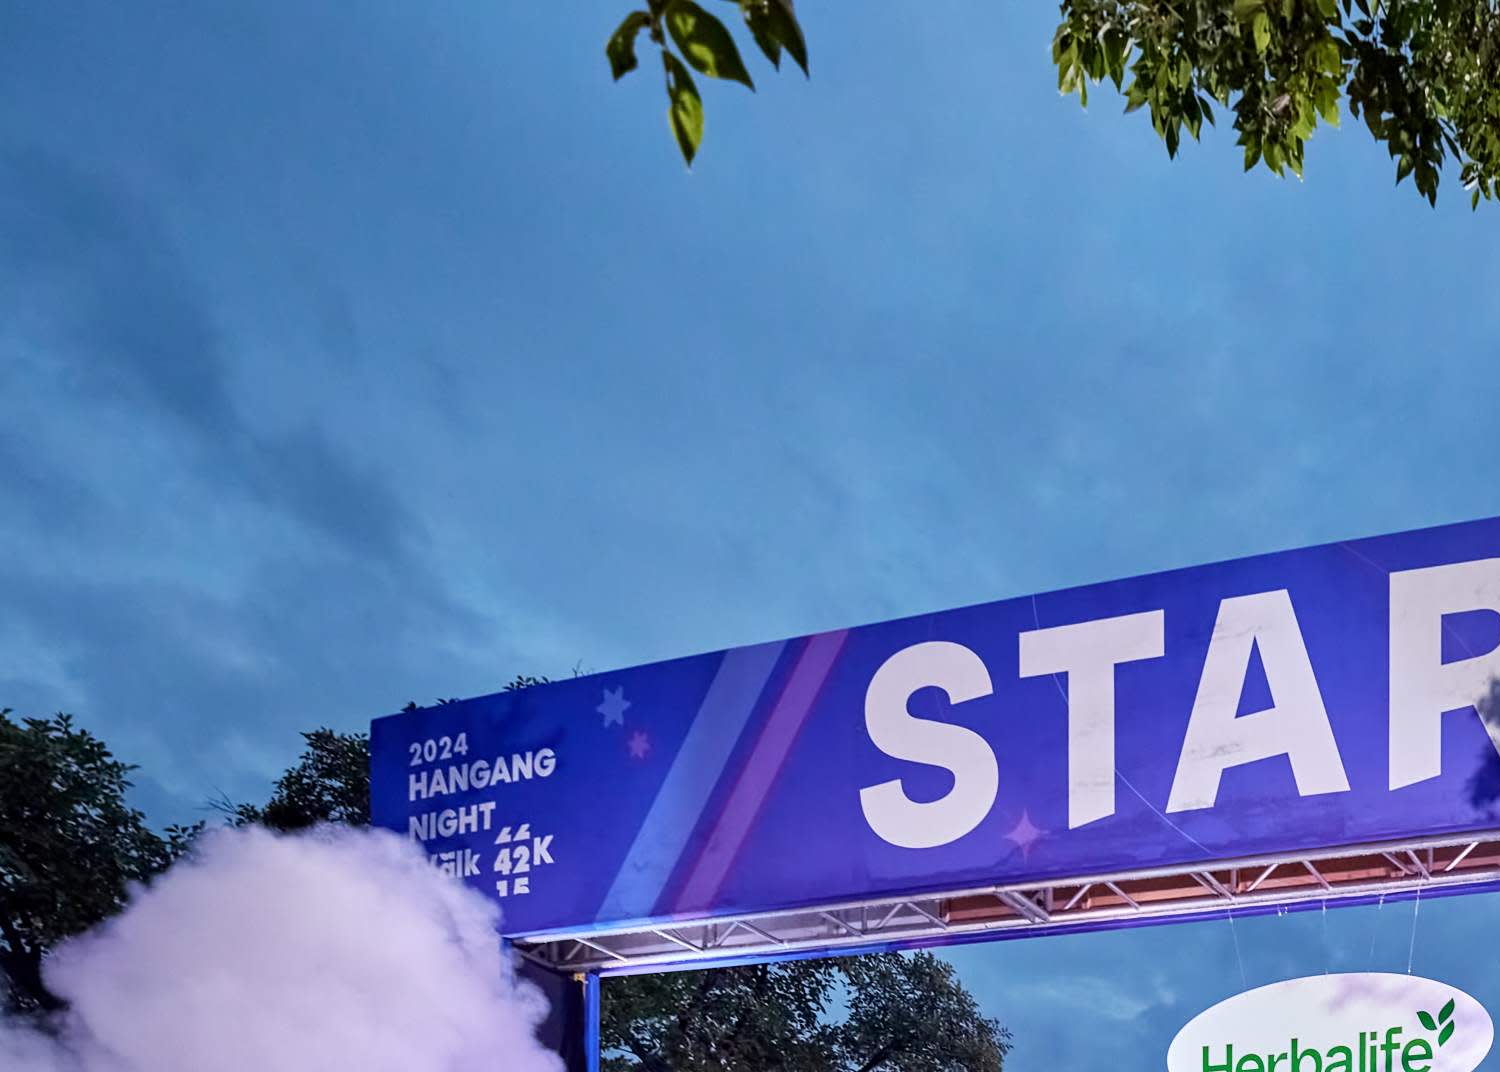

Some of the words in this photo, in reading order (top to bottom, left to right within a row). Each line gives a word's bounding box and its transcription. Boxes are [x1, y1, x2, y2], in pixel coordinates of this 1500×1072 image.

[409, 733, 469, 766] 2024
[409, 748, 556, 801] HANGANG
[409, 801, 496, 843] NIGHT
